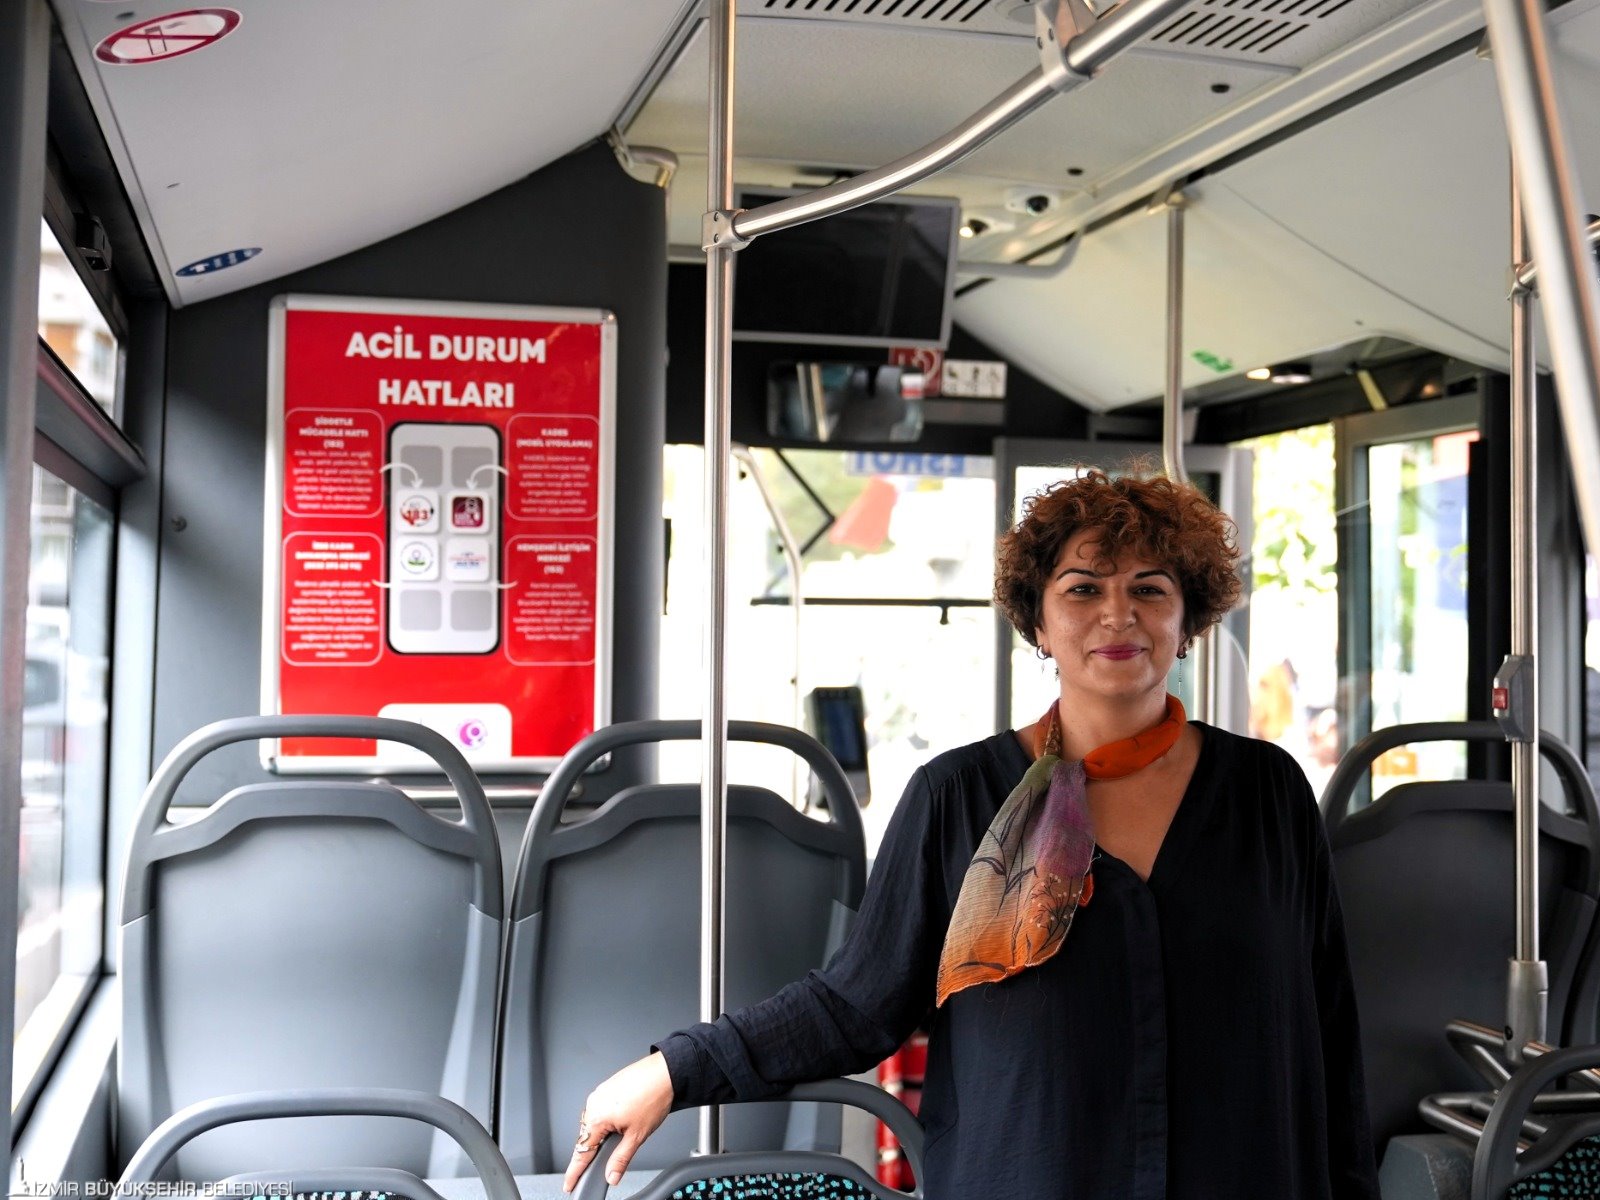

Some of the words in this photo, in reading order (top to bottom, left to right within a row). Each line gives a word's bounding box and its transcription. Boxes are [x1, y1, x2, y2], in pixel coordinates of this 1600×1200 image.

[345, 325, 421, 360] ACİL
[430, 335, 547, 364] DURUM
[378, 378, 515, 408] HATLARI
